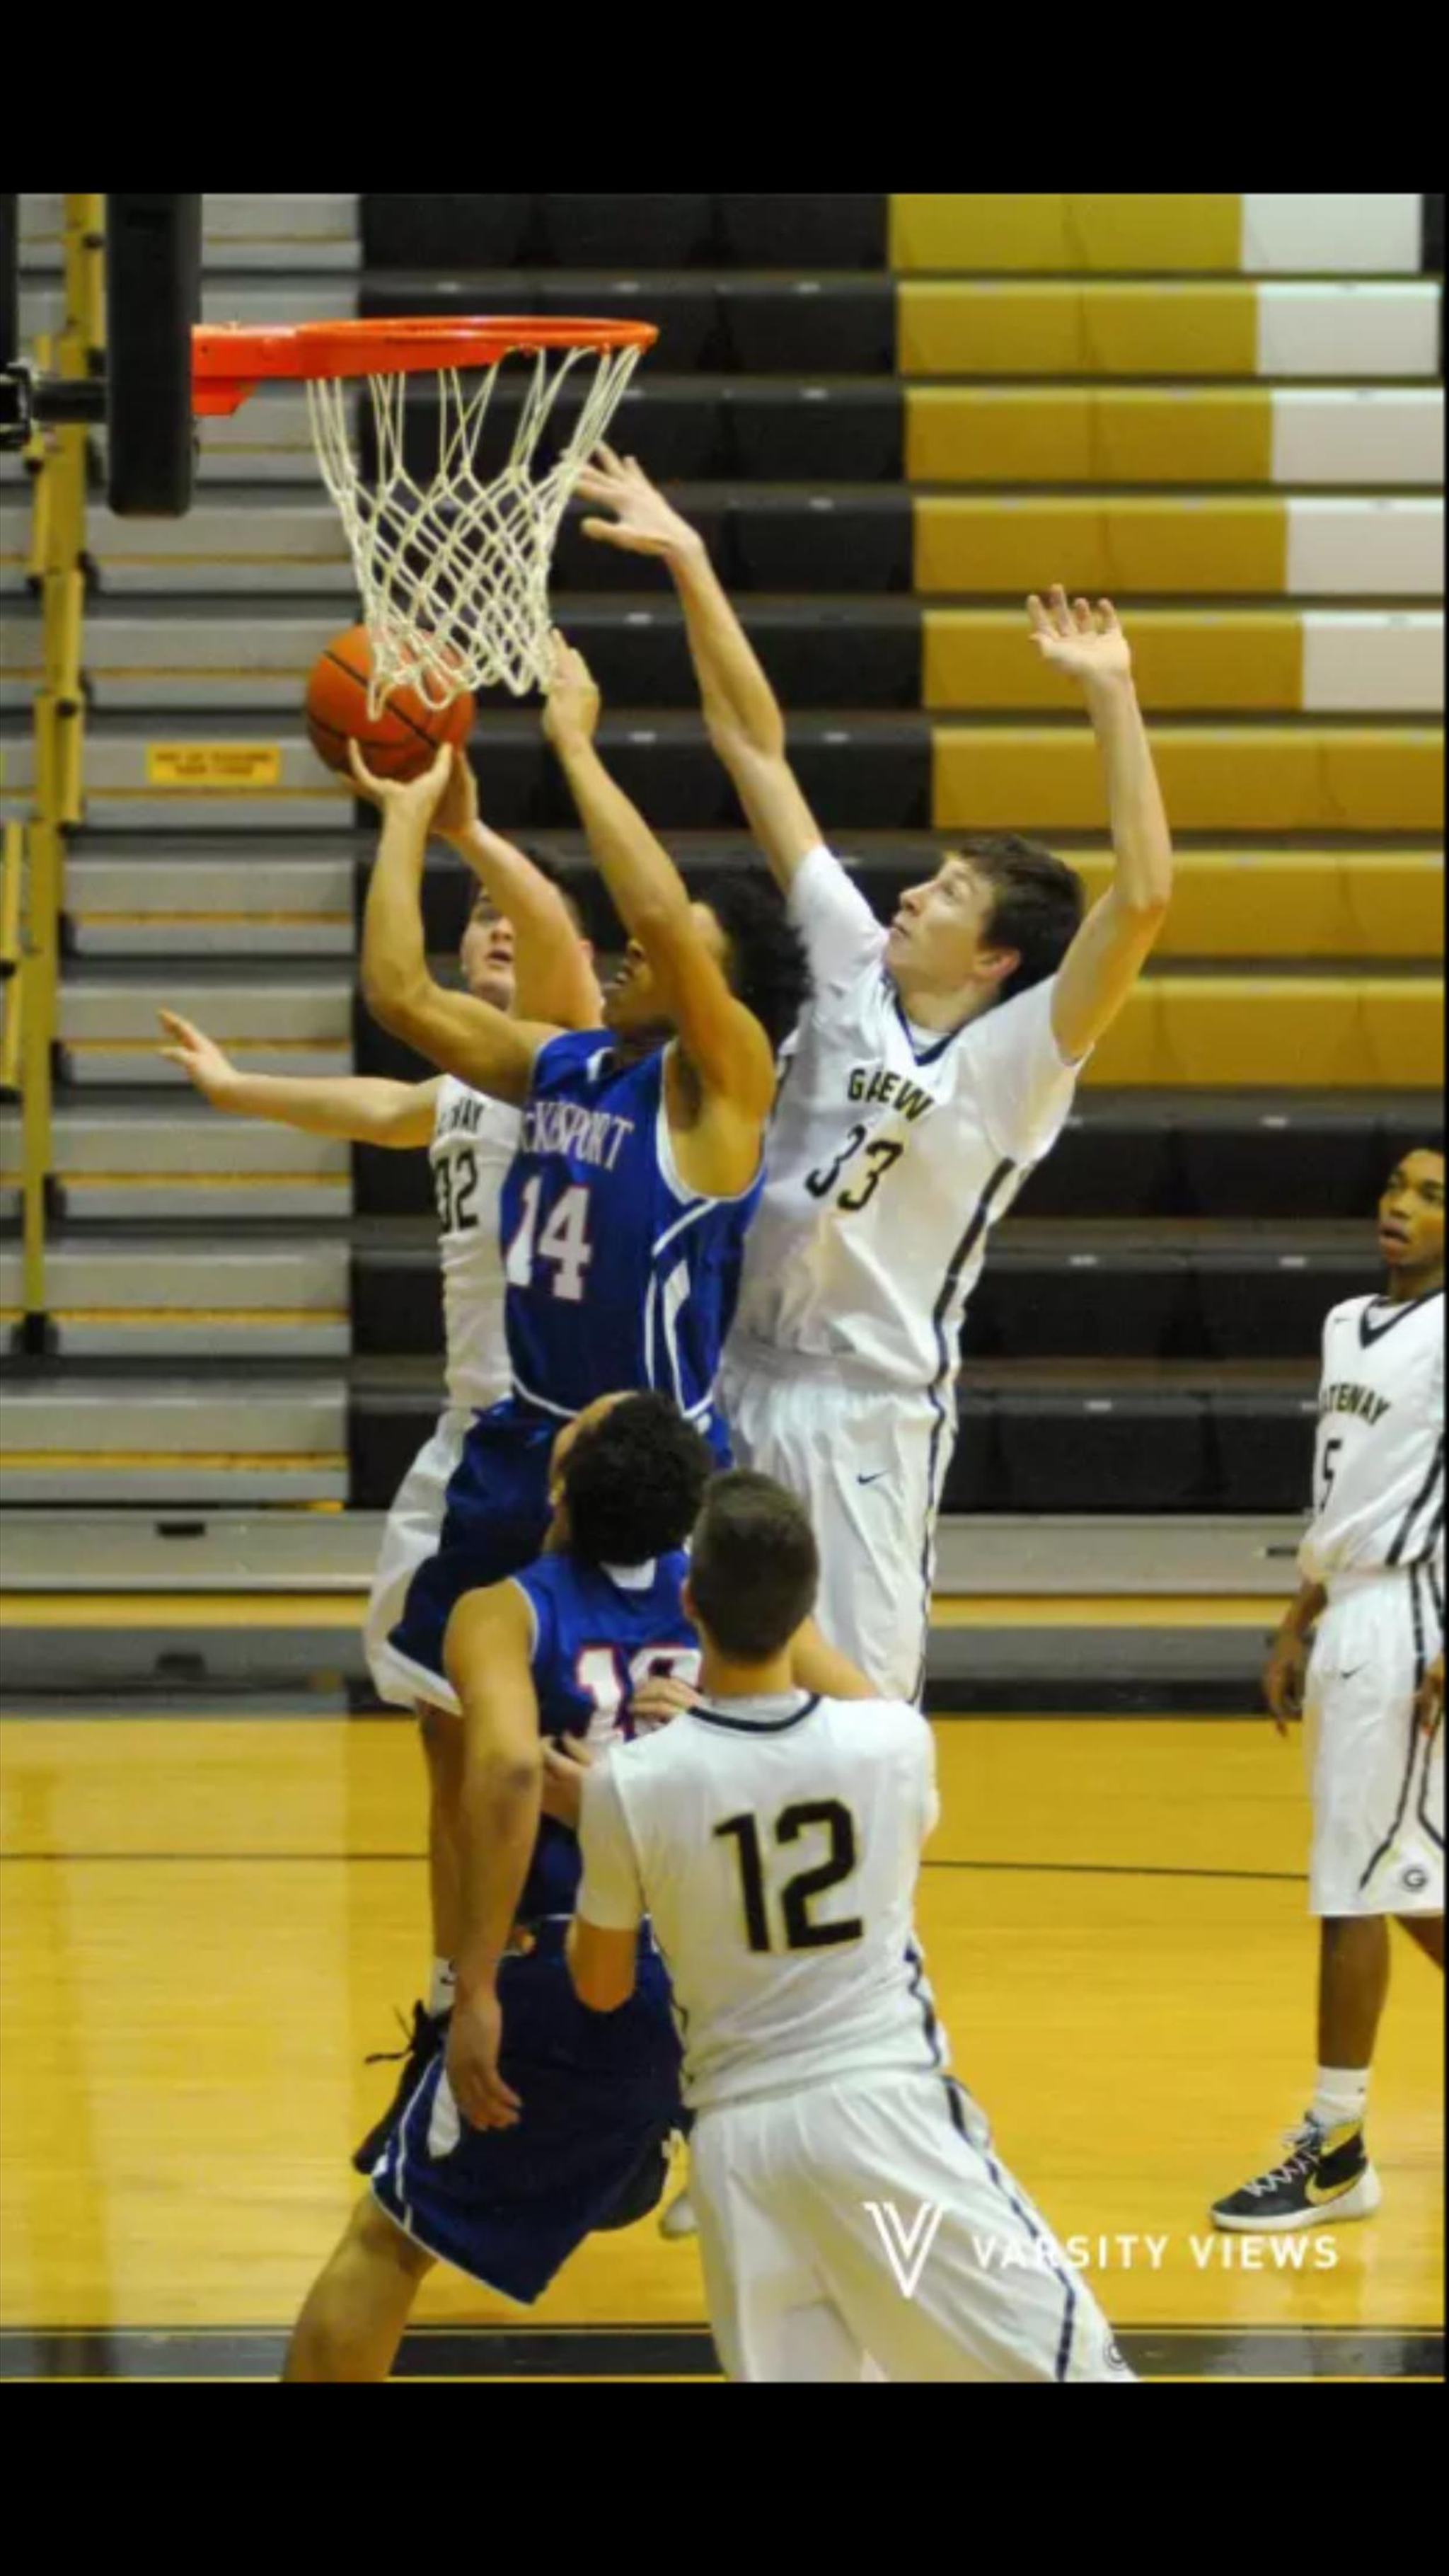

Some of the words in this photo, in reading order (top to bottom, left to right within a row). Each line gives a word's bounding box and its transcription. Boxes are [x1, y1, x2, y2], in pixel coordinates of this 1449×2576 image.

[804, 1124, 904, 1211] 33
[506, 1175, 592, 1301] 14
[1319, 1439, 1342, 1512] 5
[712, 1798, 862, 1953] 12
